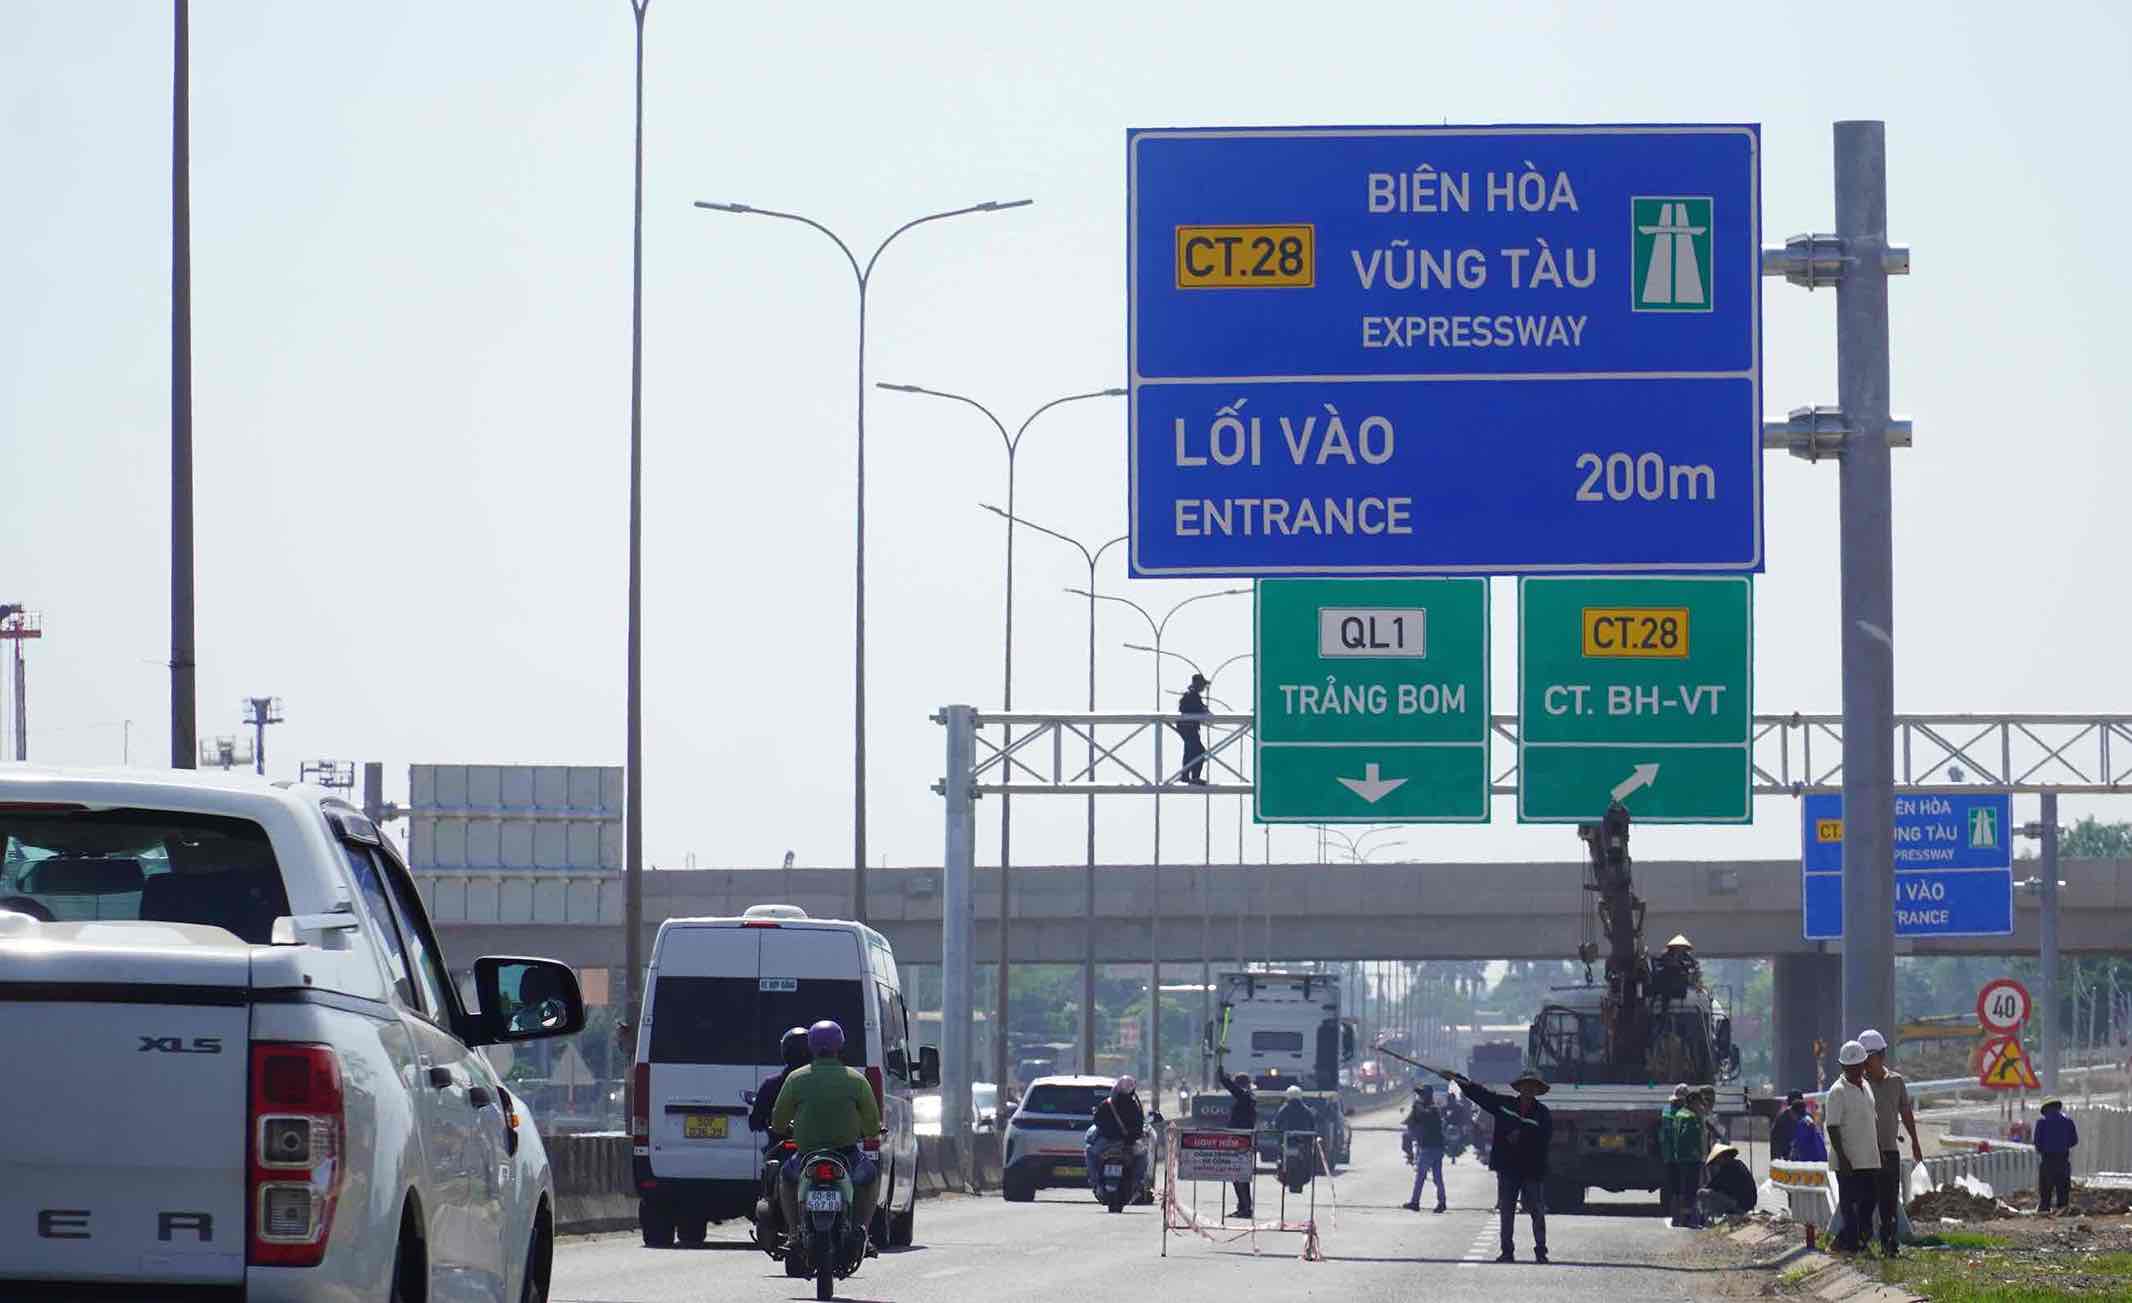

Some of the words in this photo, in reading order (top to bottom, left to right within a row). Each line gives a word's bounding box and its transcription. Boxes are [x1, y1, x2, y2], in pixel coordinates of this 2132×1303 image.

[1368, 163, 1470, 213] BIÊN
[1487, 161, 1579, 212] HÒA
[1184, 235, 1304, 278] CT.28
[1351, 239, 1487, 290] VŨNG
[1501, 238, 1596, 289] TÀU
[1363, 315, 1587, 348] EXPRESSWAY
[1175, 398, 1262, 466] LỐI
[1279, 403, 1395, 465] VÀO
[1575, 452, 1716, 501] 200m
[1175, 497, 1412, 536] ENTRANCE
[1340, 616, 1404, 649] QL1
[1592, 616, 1679, 650] CT.28
[1279, 674, 1388, 715] TRẢNG
[1400, 684, 1466, 715] BOM
[1544, 685, 1593, 716] CT.
[1608, 685, 1727, 716] BH-VT
[1895, 797, 1916, 816] ÊN
[1919, 796, 1952, 815] HÒA
[1819, 824, 1843, 840] CT.
[1925, 825, 1958, 842] TÀU
[1894, 848, 1954, 862] PRESSWAY
[1906, 878, 1945, 901] VÀO
[1895, 910, 1949, 925] RANCE
[1992, 994, 2015, 1018] 40
[138, 1036, 222, 1054] XLS
